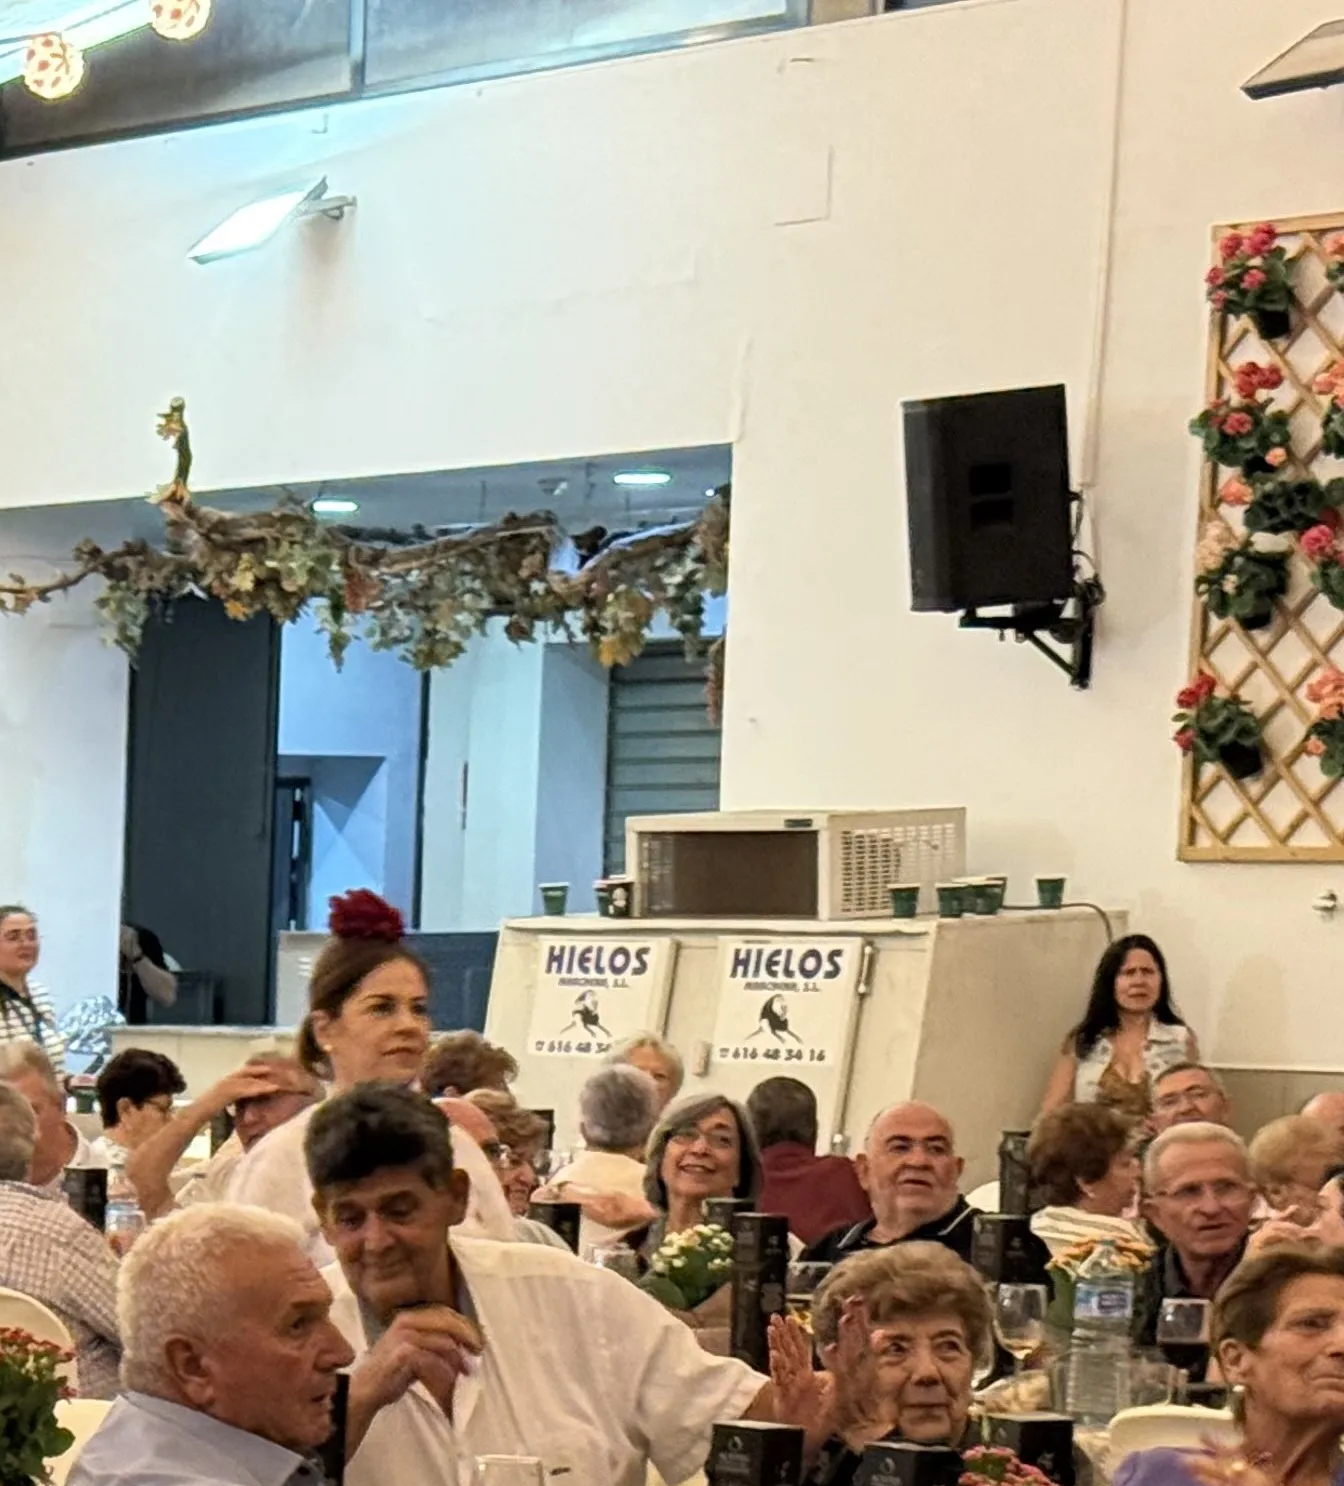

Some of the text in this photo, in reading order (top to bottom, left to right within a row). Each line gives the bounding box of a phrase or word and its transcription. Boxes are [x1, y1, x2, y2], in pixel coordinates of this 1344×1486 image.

[545, 945, 651, 976] HIELOS
[729, 948, 844, 979] HIELOS
[547, 1041, 572, 1053] 616
[732, 1047, 826, 1061] 616 48 34 16
